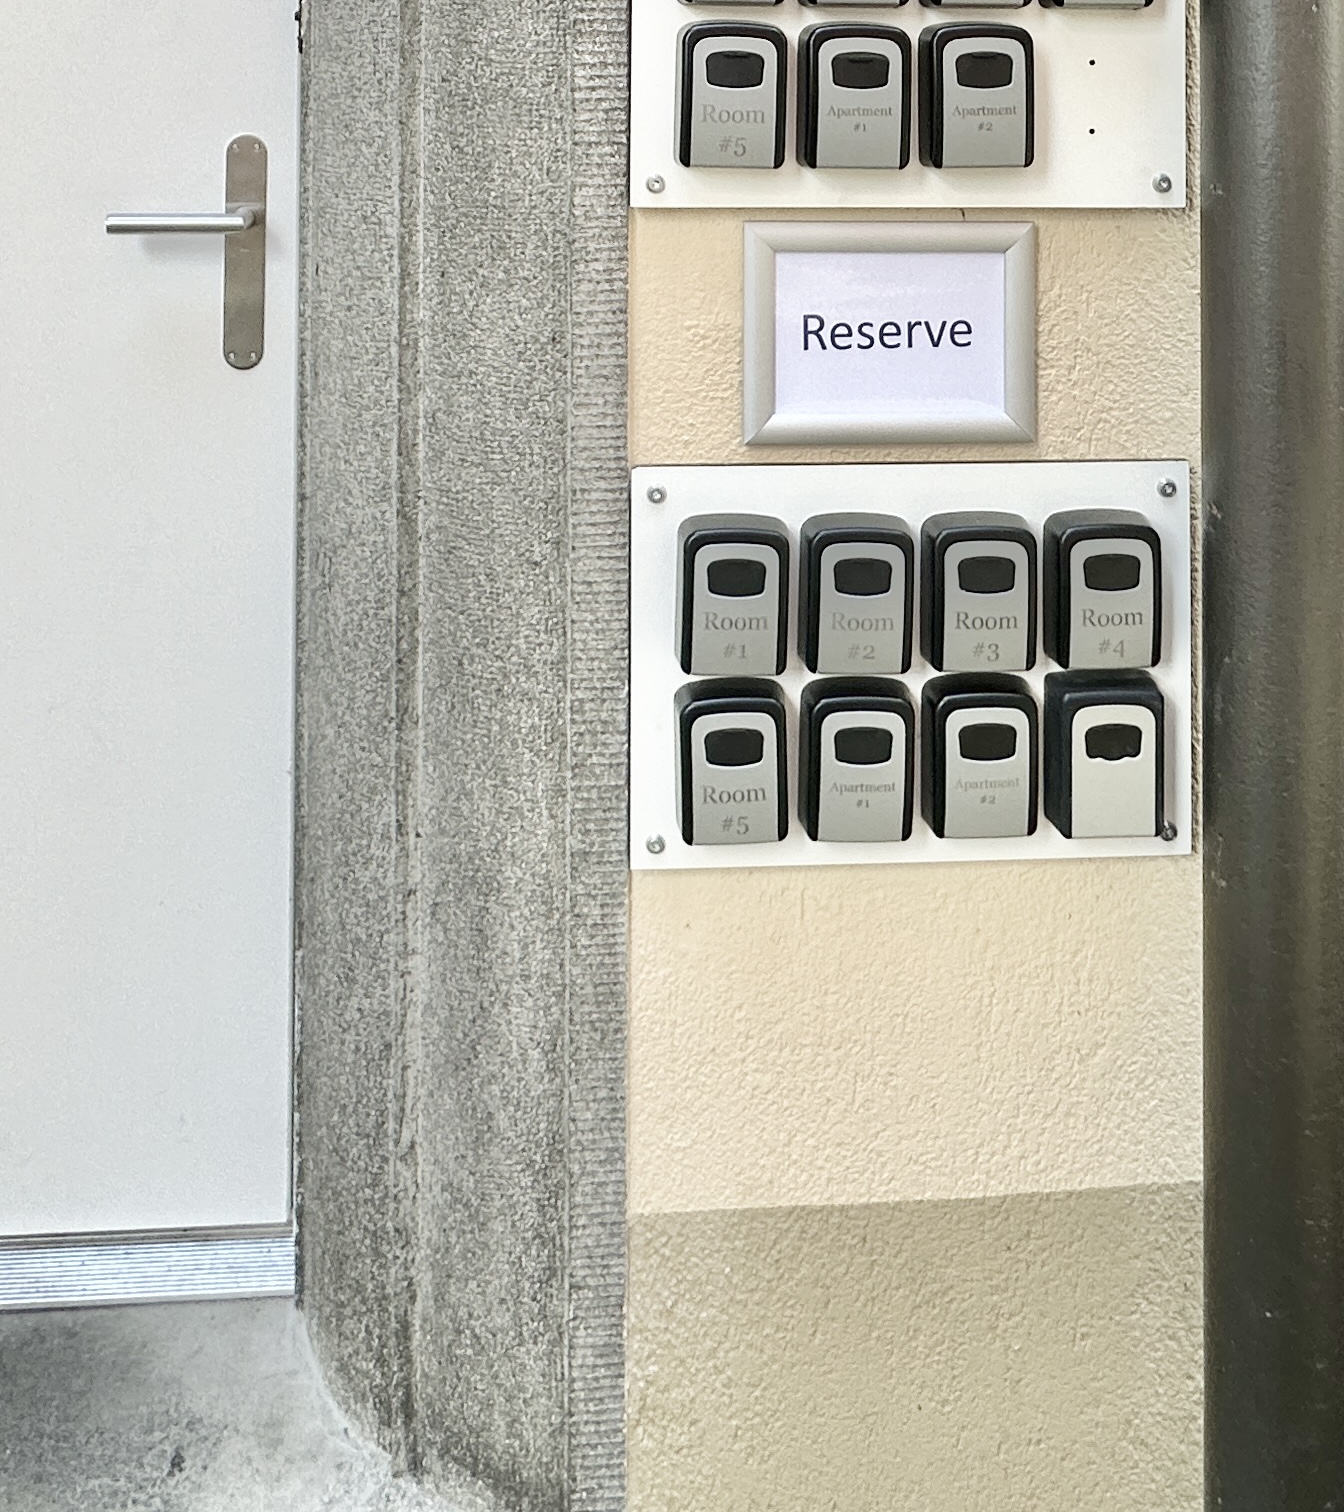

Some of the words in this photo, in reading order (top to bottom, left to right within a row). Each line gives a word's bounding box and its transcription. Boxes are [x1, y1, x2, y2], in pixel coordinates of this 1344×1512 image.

[700, 104, 766, 125] Room
[827, 105, 893, 119] Apartment
[952, 104, 1017, 119] Apartment
[853, 123, 867, 133] #1
[977, 122, 993, 133] #2
[718, 137, 747, 158] #5
[802, 314, 973, 351] Reserve
[703, 610, 769, 632] Room
[831, 610, 895, 632] Room
[954, 609, 1019, 631] Room
[1081, 607, 1144, 629] Room
[723, 643, 749, 660] #1
[847, 644, 876, 662] #2
[971, 641, 1000, 664] #3
[1098, 638, 1126, 659] #4
[701, 784, 767, 805] Room
[830, 781, 896, 796] Apartment
[956, 776, 1021, 792] Apartment
[856, 799, 870, 809] #1
[980, 794, 996, 805] #2
[720, 815, 750, 836] #5
